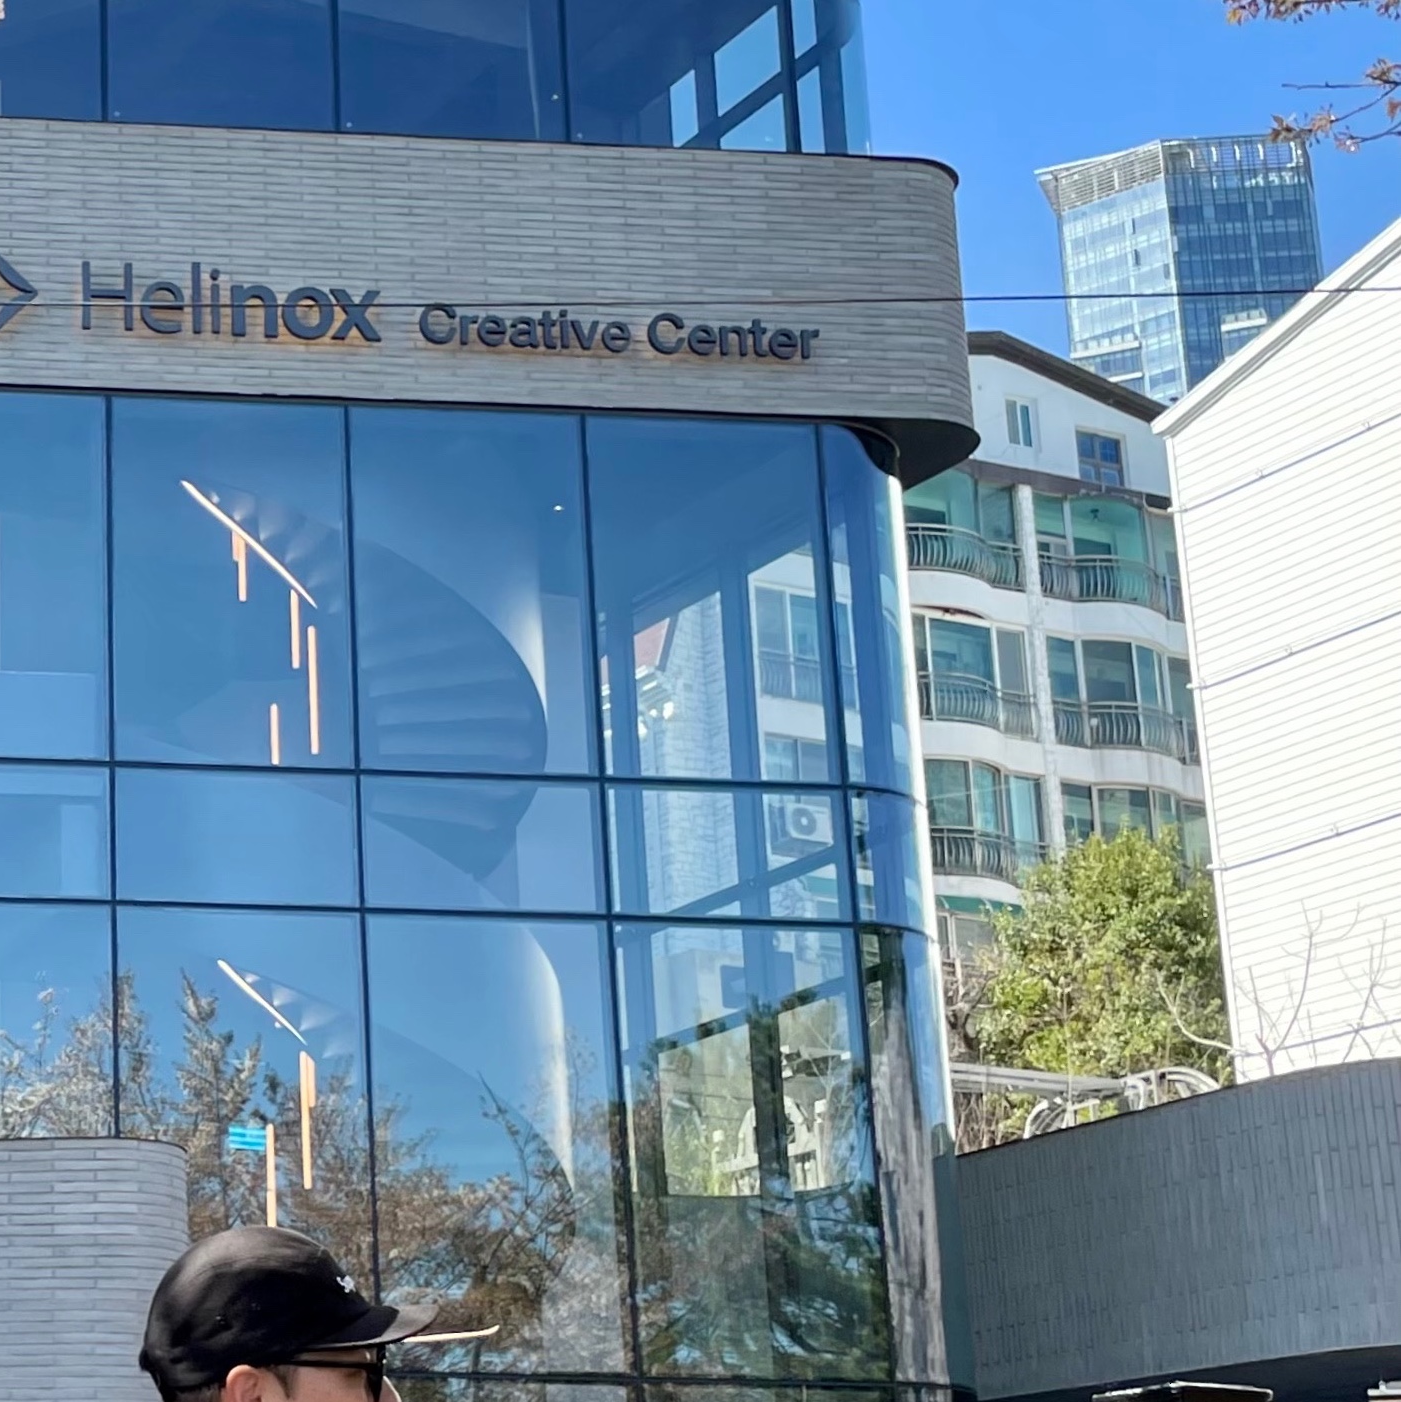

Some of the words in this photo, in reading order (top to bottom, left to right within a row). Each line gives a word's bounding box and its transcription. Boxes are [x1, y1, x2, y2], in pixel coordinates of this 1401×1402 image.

[81, 260, 383, 343] Helinox
[418, 303, 632, 354] Creative
[647, 312, 821, 360] Center
